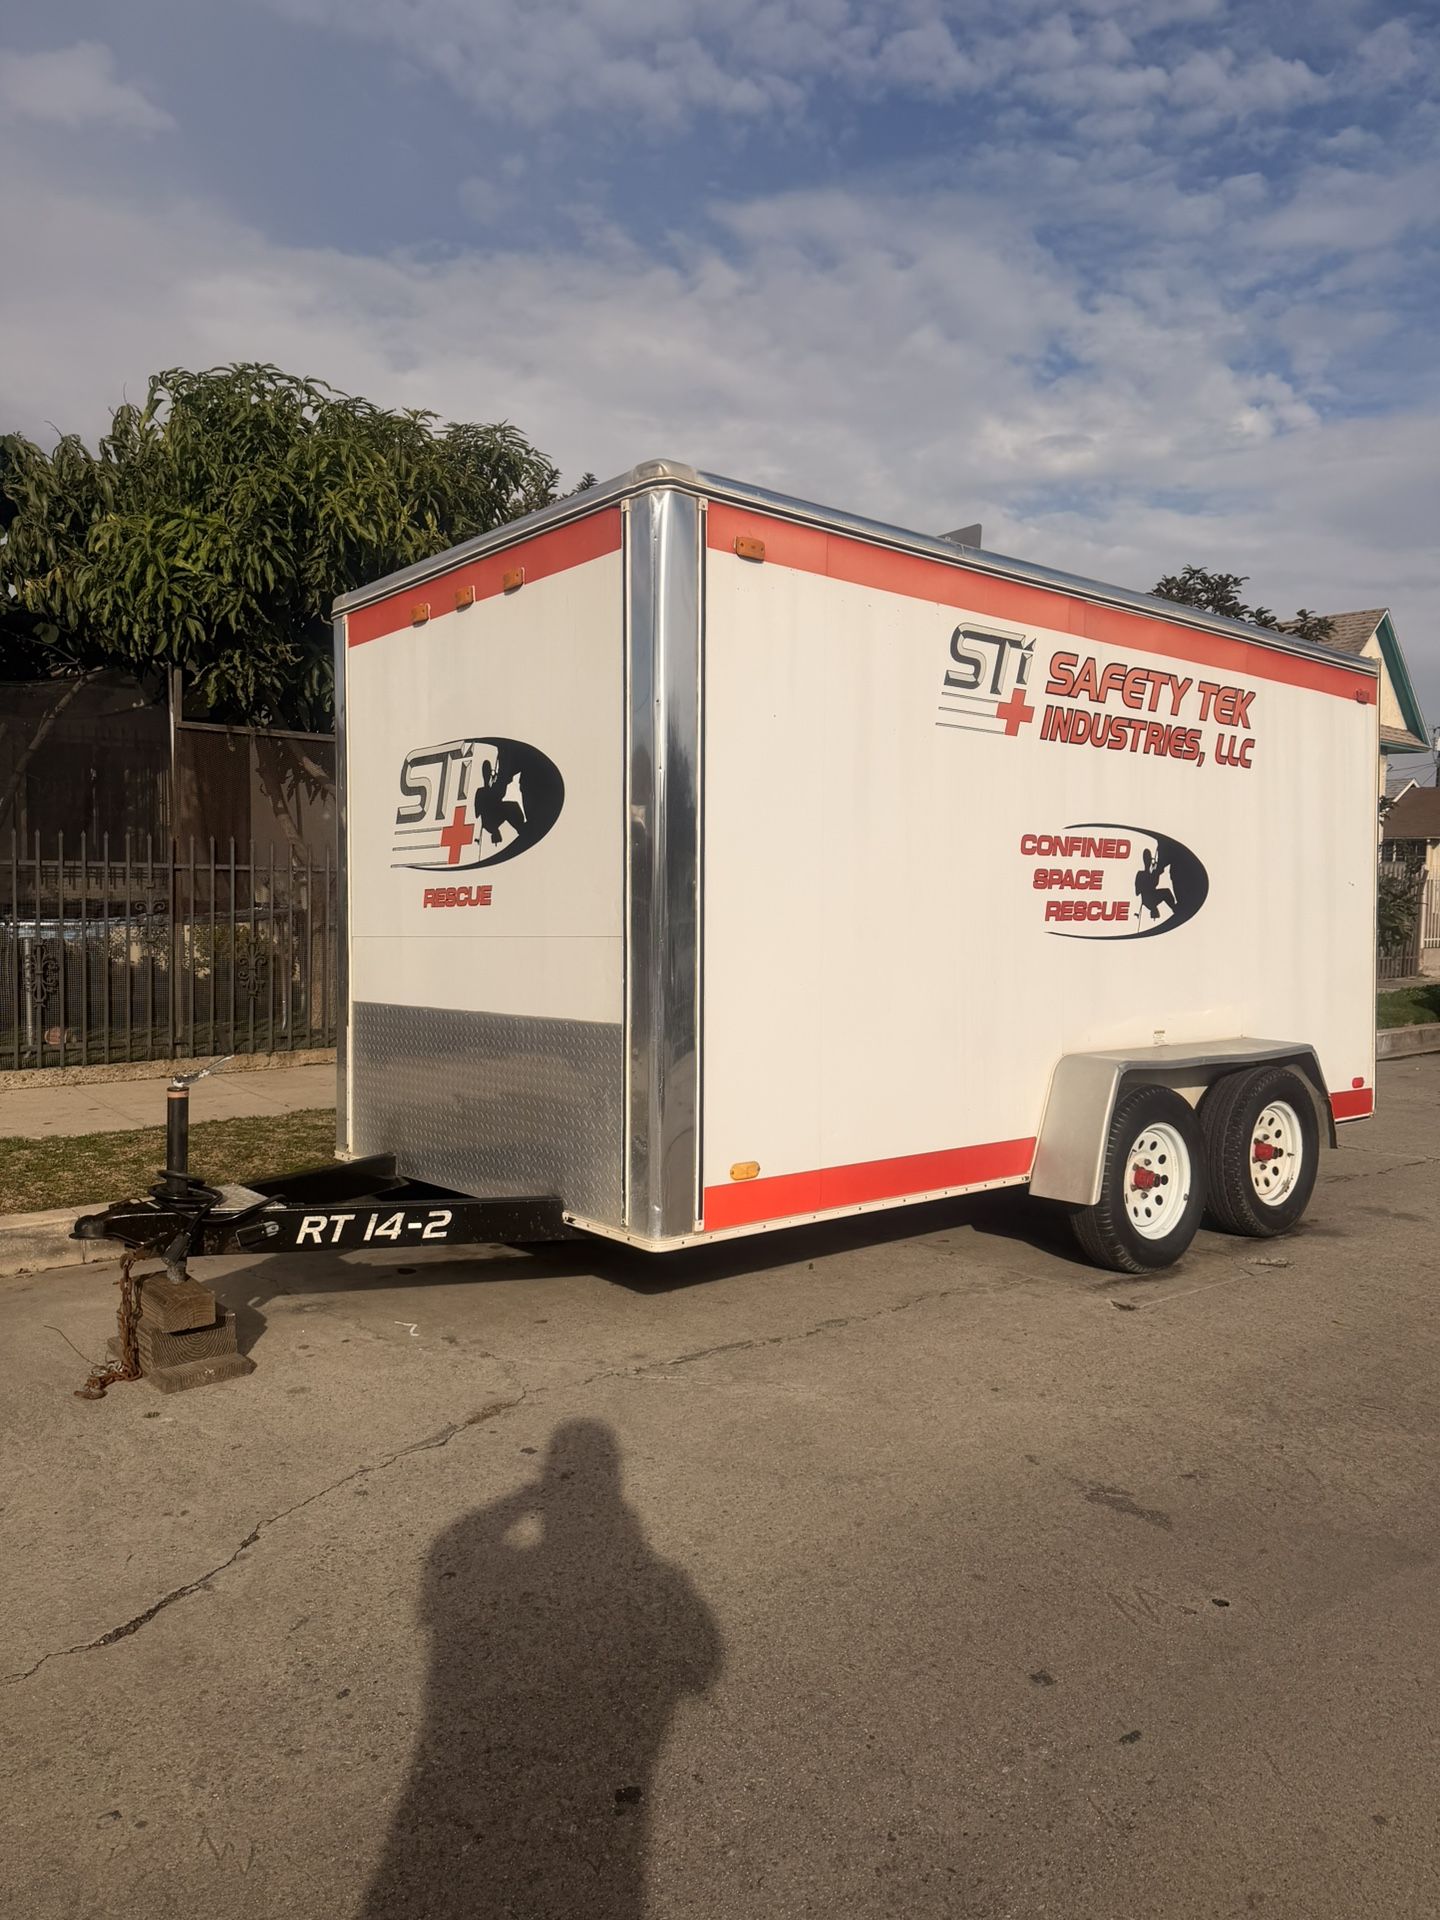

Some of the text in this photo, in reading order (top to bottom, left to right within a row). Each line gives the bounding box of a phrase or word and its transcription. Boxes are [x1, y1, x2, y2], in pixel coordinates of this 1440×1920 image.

[1045, 651, 1256, 729] SAFETY TEK
[1039, 705, 1256, 769] INDUSTRIES, LLC
[1020, 834, 1132, 859] CONFINED
[1032, 868, 1104, 890] SPACE
[423, 885, 493, 908] RESCUE
[1044, 900, 1130, 922] RESCUE
[296, 1209, 453, 1244] RT 14-2
